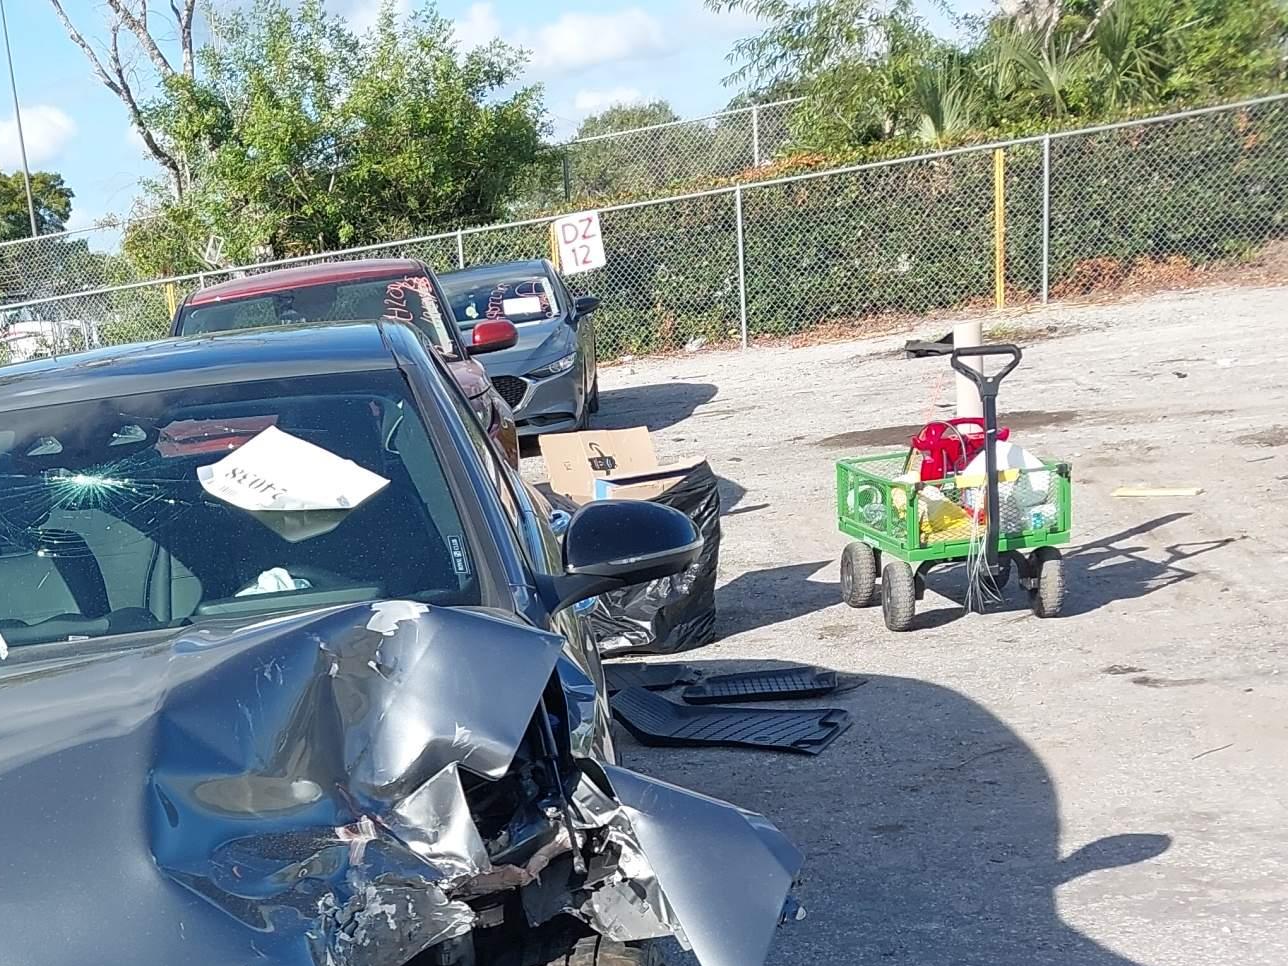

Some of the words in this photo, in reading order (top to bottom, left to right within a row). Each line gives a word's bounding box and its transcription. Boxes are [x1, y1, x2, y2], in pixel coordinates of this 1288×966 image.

[561, 217, 597, 245] DZ
[571, 244, 593, 267] 12
[224, 466, 289, 501] 24038
